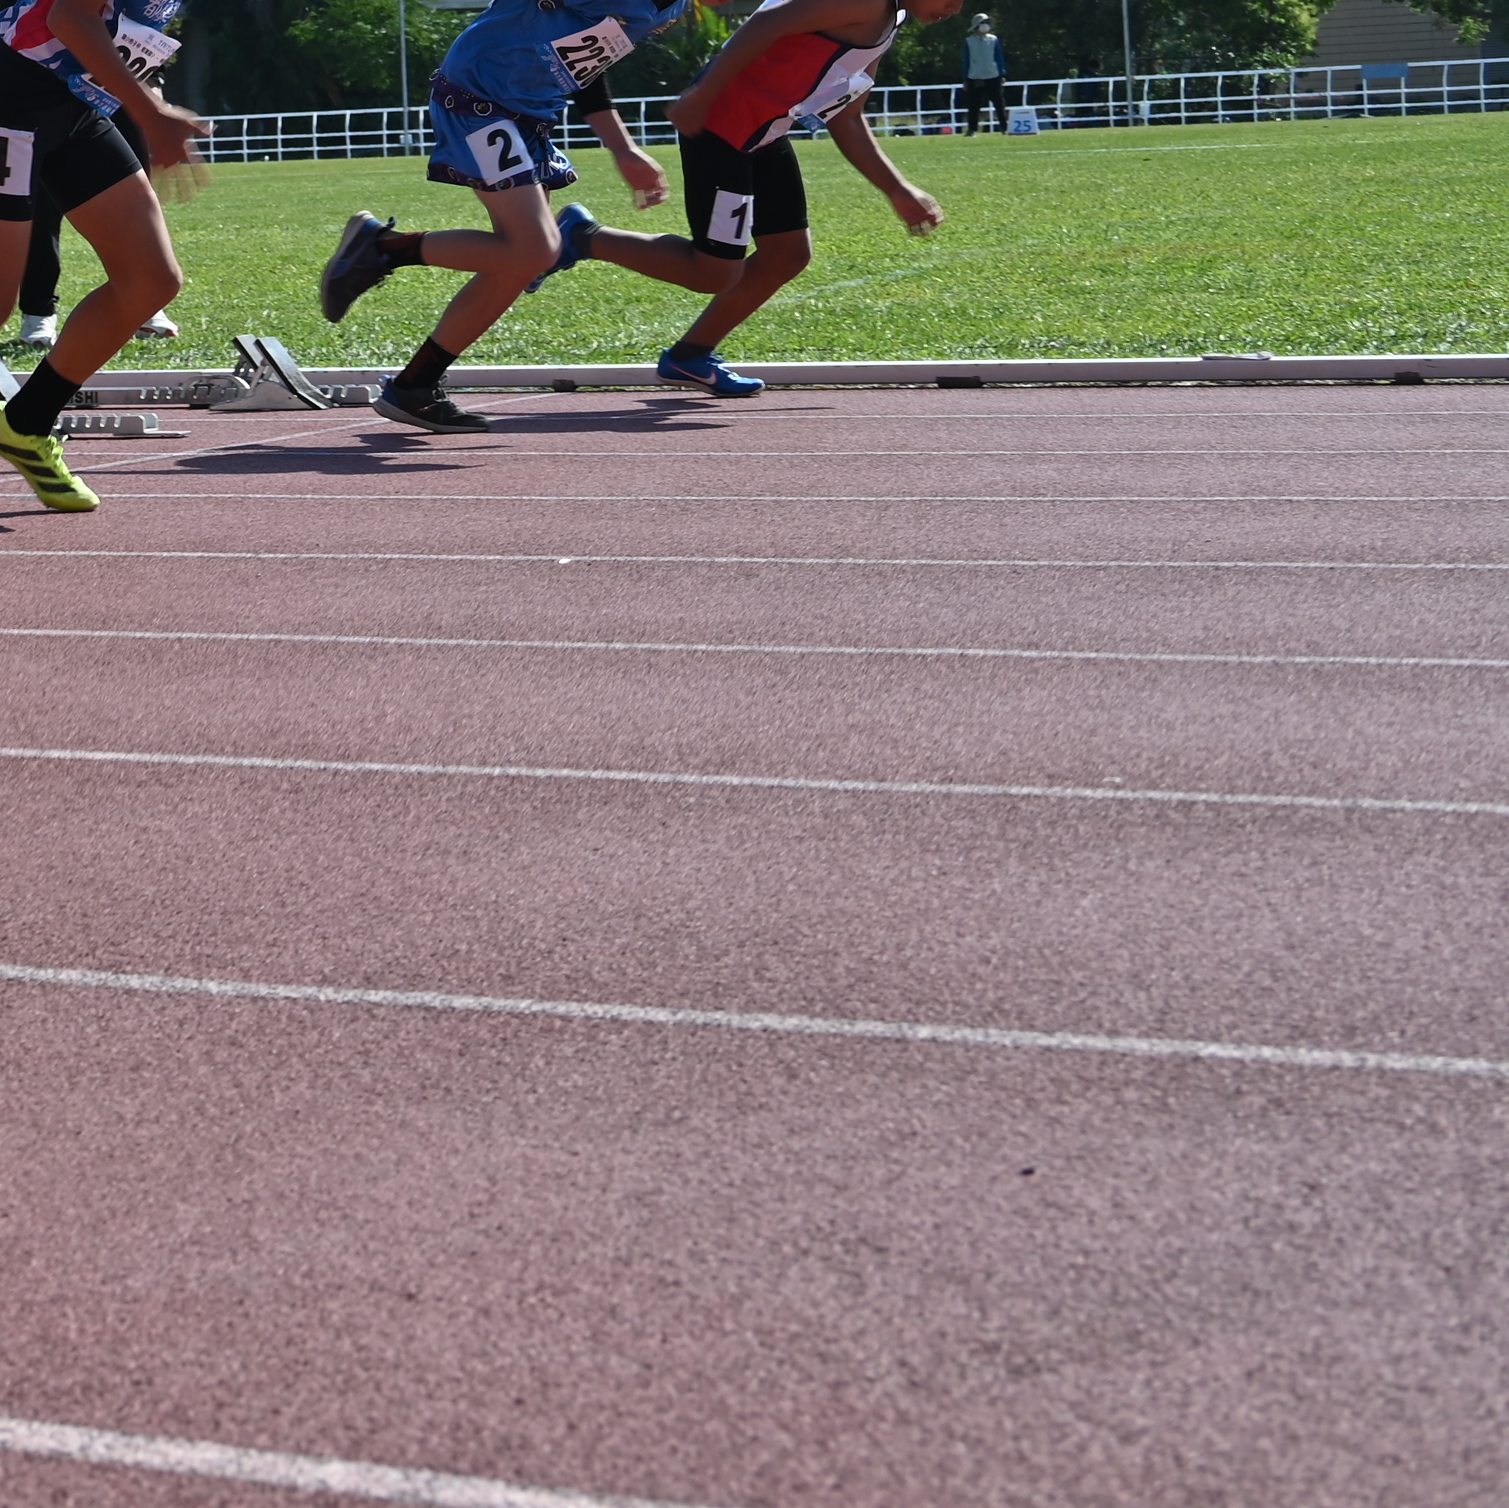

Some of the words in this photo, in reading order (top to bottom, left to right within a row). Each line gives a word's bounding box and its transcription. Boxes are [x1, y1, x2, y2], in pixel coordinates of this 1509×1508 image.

[1014, 120, 1031, 133] 25
[486, 128, 523, 172] 2
[731, 203, 748, 239] 1
